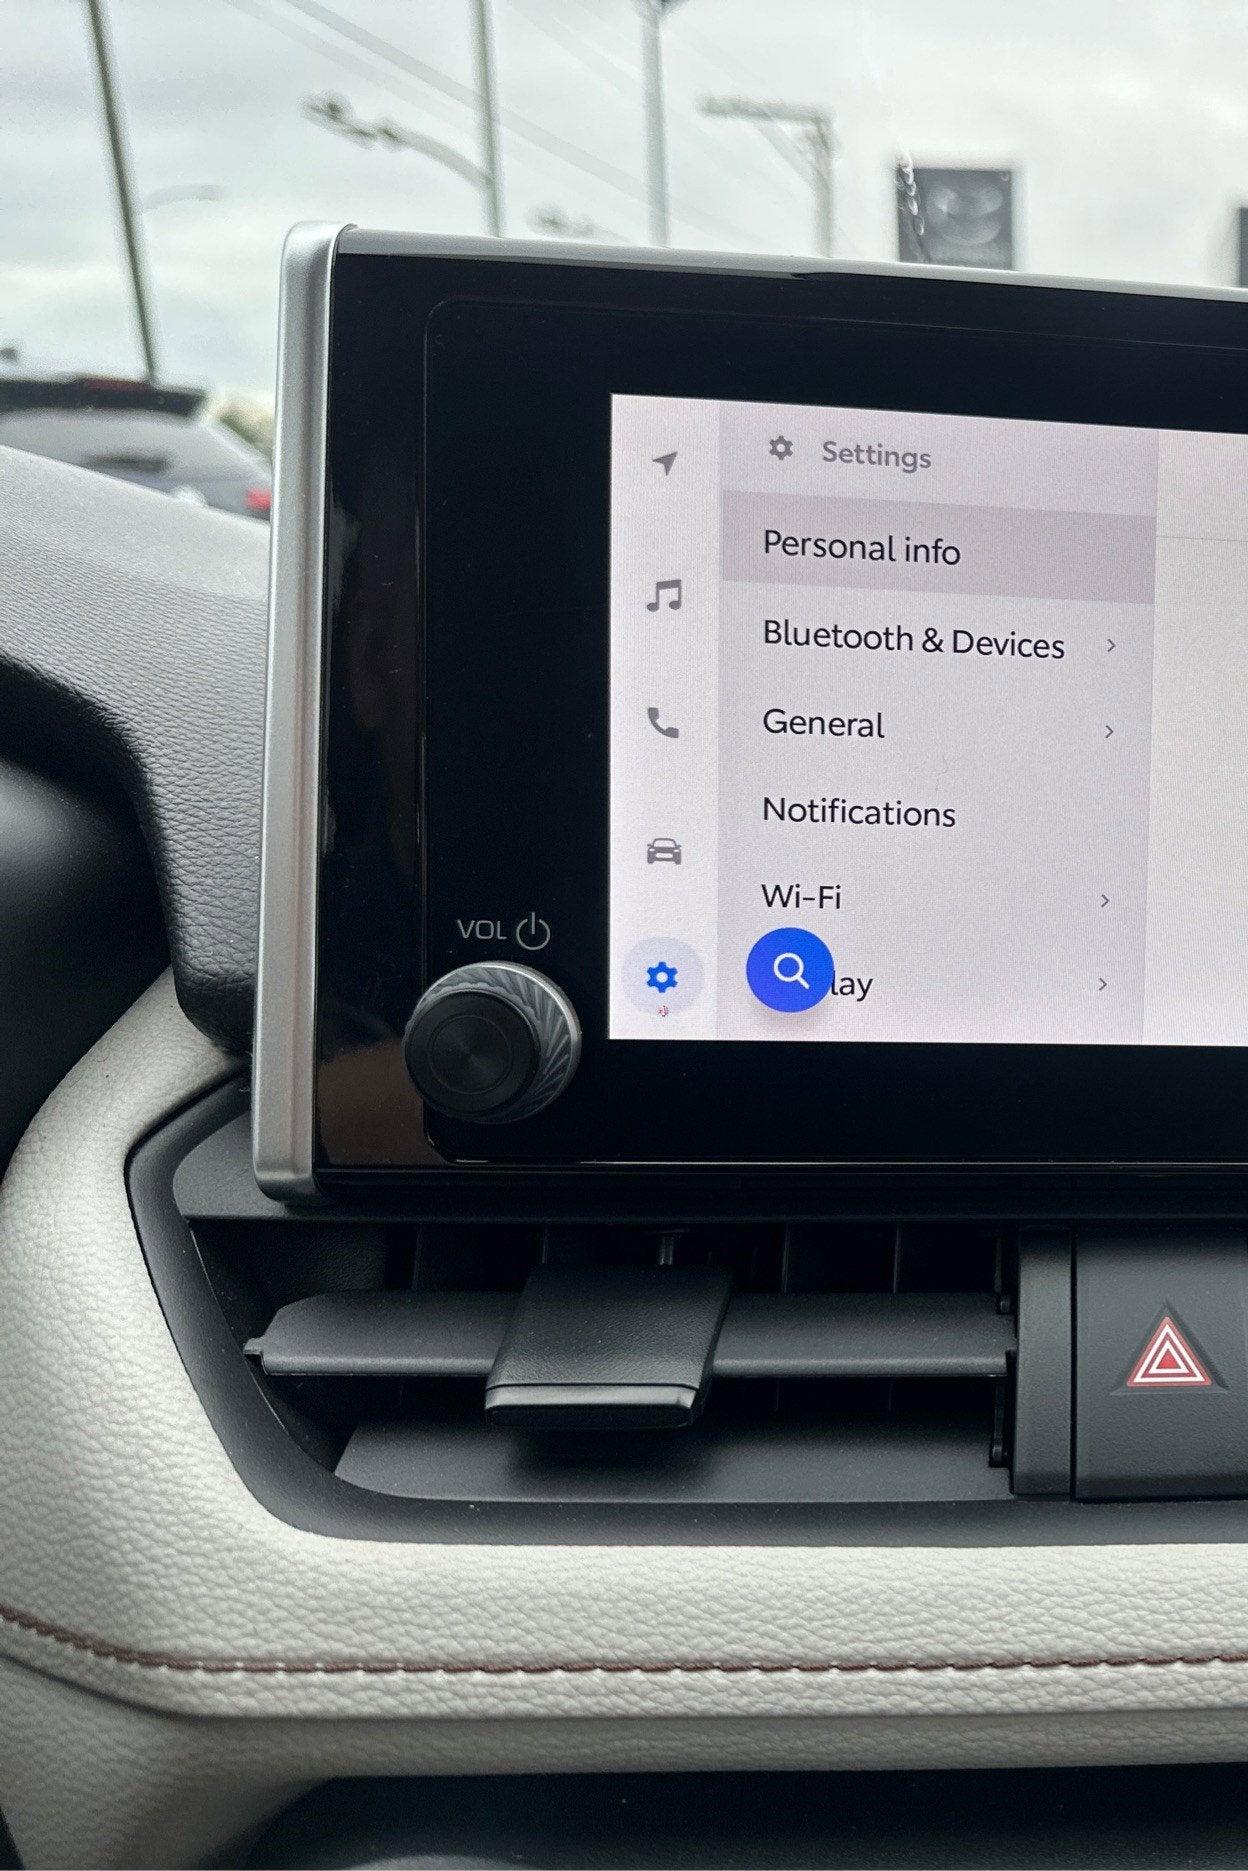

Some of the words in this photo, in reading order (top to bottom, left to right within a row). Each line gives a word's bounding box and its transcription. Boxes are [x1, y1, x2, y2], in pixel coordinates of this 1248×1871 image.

[822, 440, 932, 474] Settings
[764, 529, 897, 563] Personal
[904, 536, 962, 567] info
[764, 618, 913, 652] Bluetooth
[921, 627, 945, 654] &
[952, 629, 1065, 661] Devices
[763, 708, 885, 740] General
[763, 796, 956, 828] Notifications
[761, 883, 842, 911] Wi-Fi
[456, 918, 508, 941] VOL
